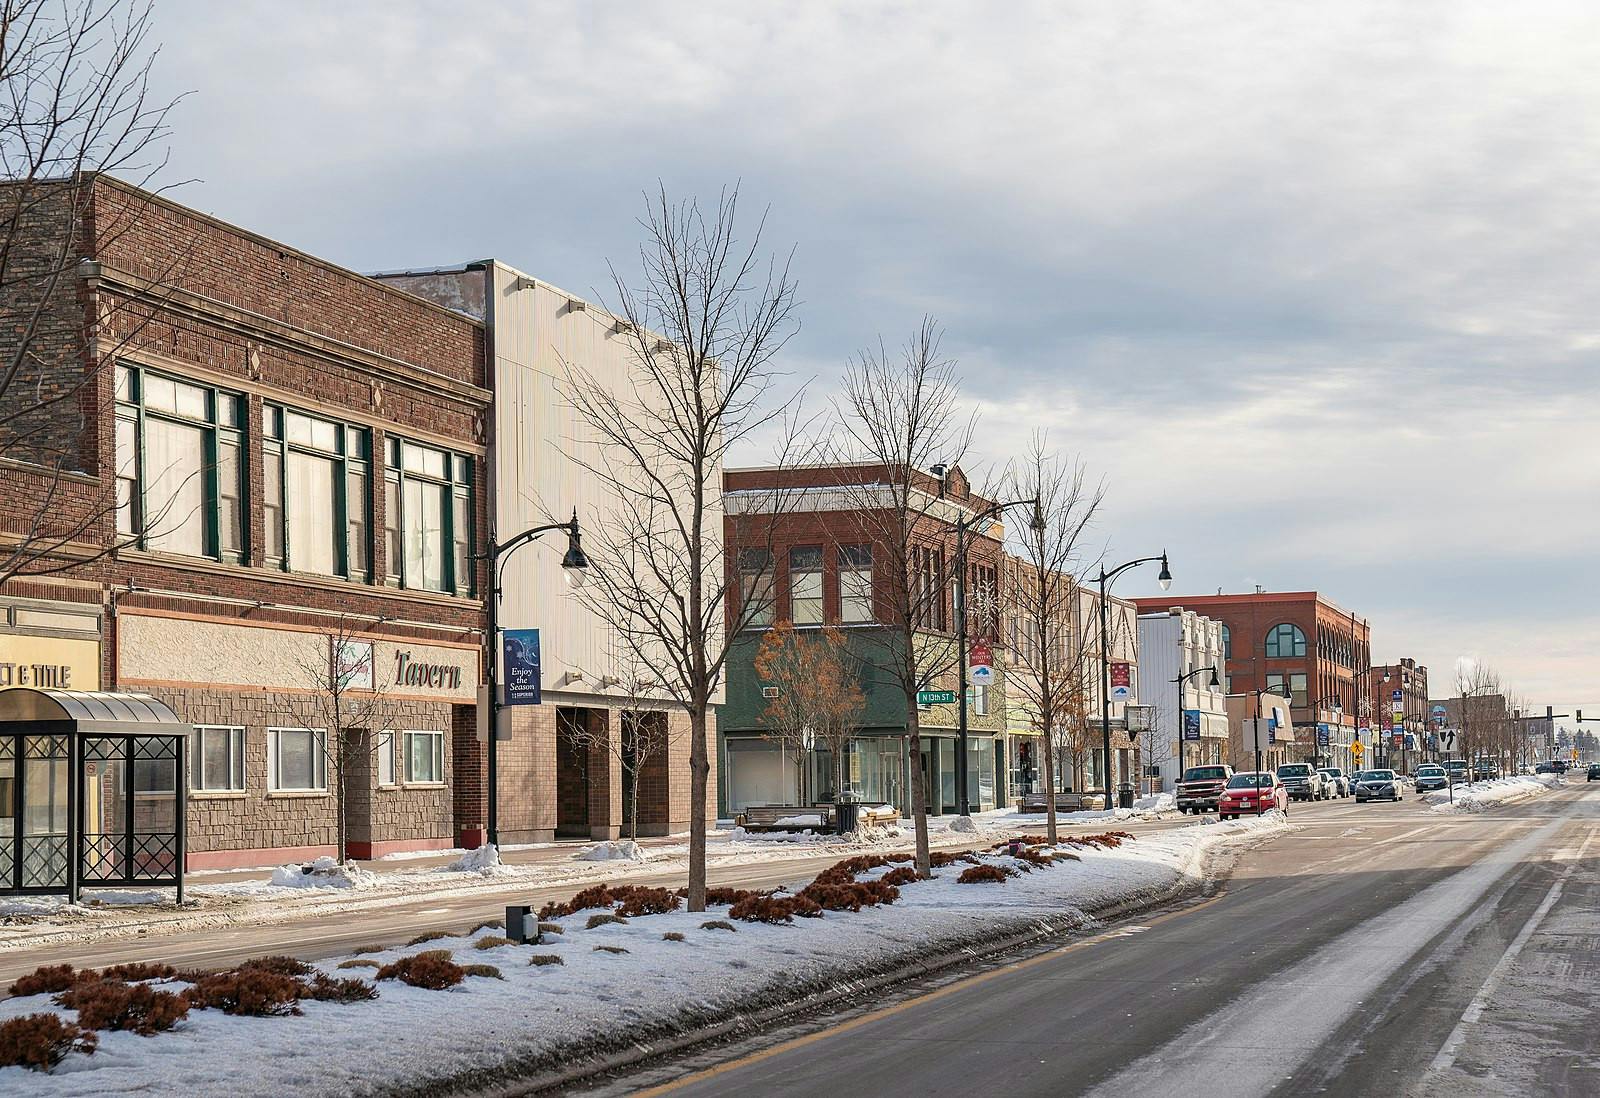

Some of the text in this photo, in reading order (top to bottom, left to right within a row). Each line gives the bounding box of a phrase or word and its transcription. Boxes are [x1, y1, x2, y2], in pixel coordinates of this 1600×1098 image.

[395, 649, 461, 689] Tavern
[511, 667, 533, 677] Enjoy
[32, 664, 71, 688] TITLE
[516, 676, 528, 684] the
[509, 682, 535, 691] Season
[922, 693, 950, 701] N 13th ST
